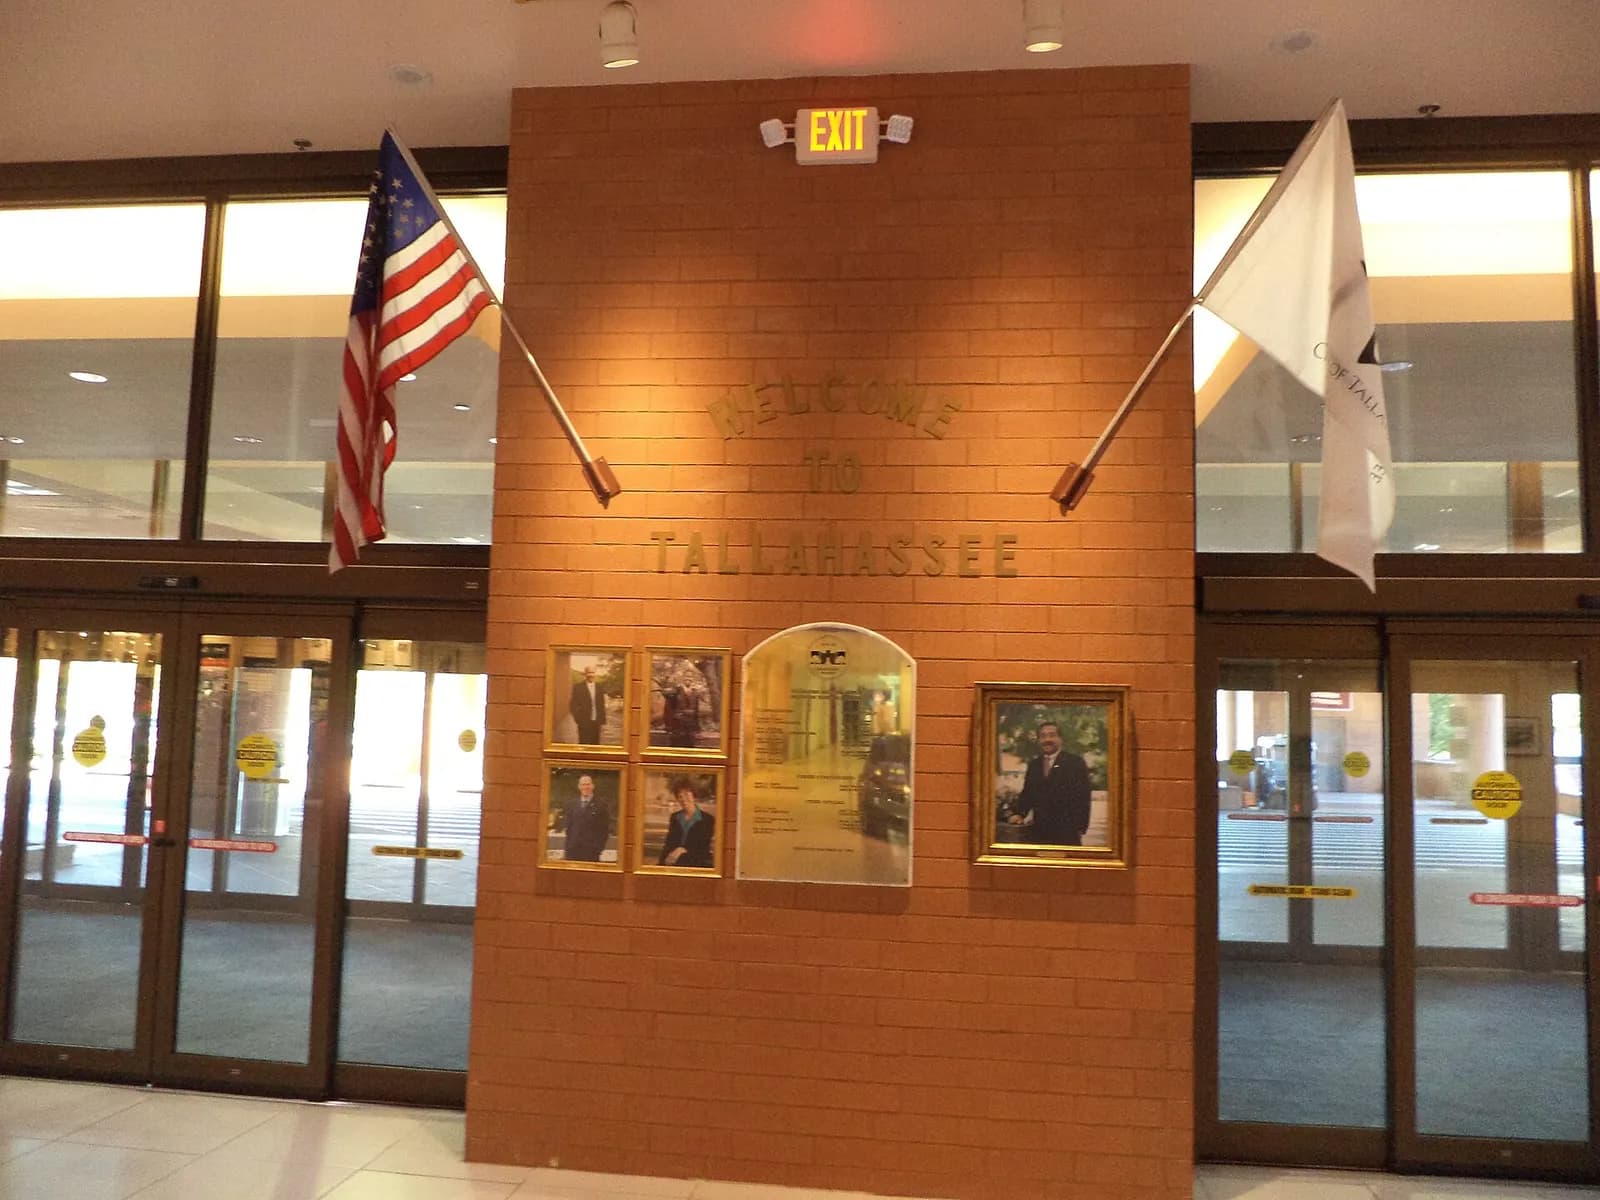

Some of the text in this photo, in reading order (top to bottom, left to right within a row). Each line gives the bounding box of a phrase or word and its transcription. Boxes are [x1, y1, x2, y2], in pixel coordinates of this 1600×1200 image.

[808, 109, 868, 152] EXIT
[1329, 362, 1349, 380] OF
[705, 371, 964, 440] WELCOME
[803, 448, 862, 494] TO
[650, 531, 1019, 579] TALLAHASSEE
